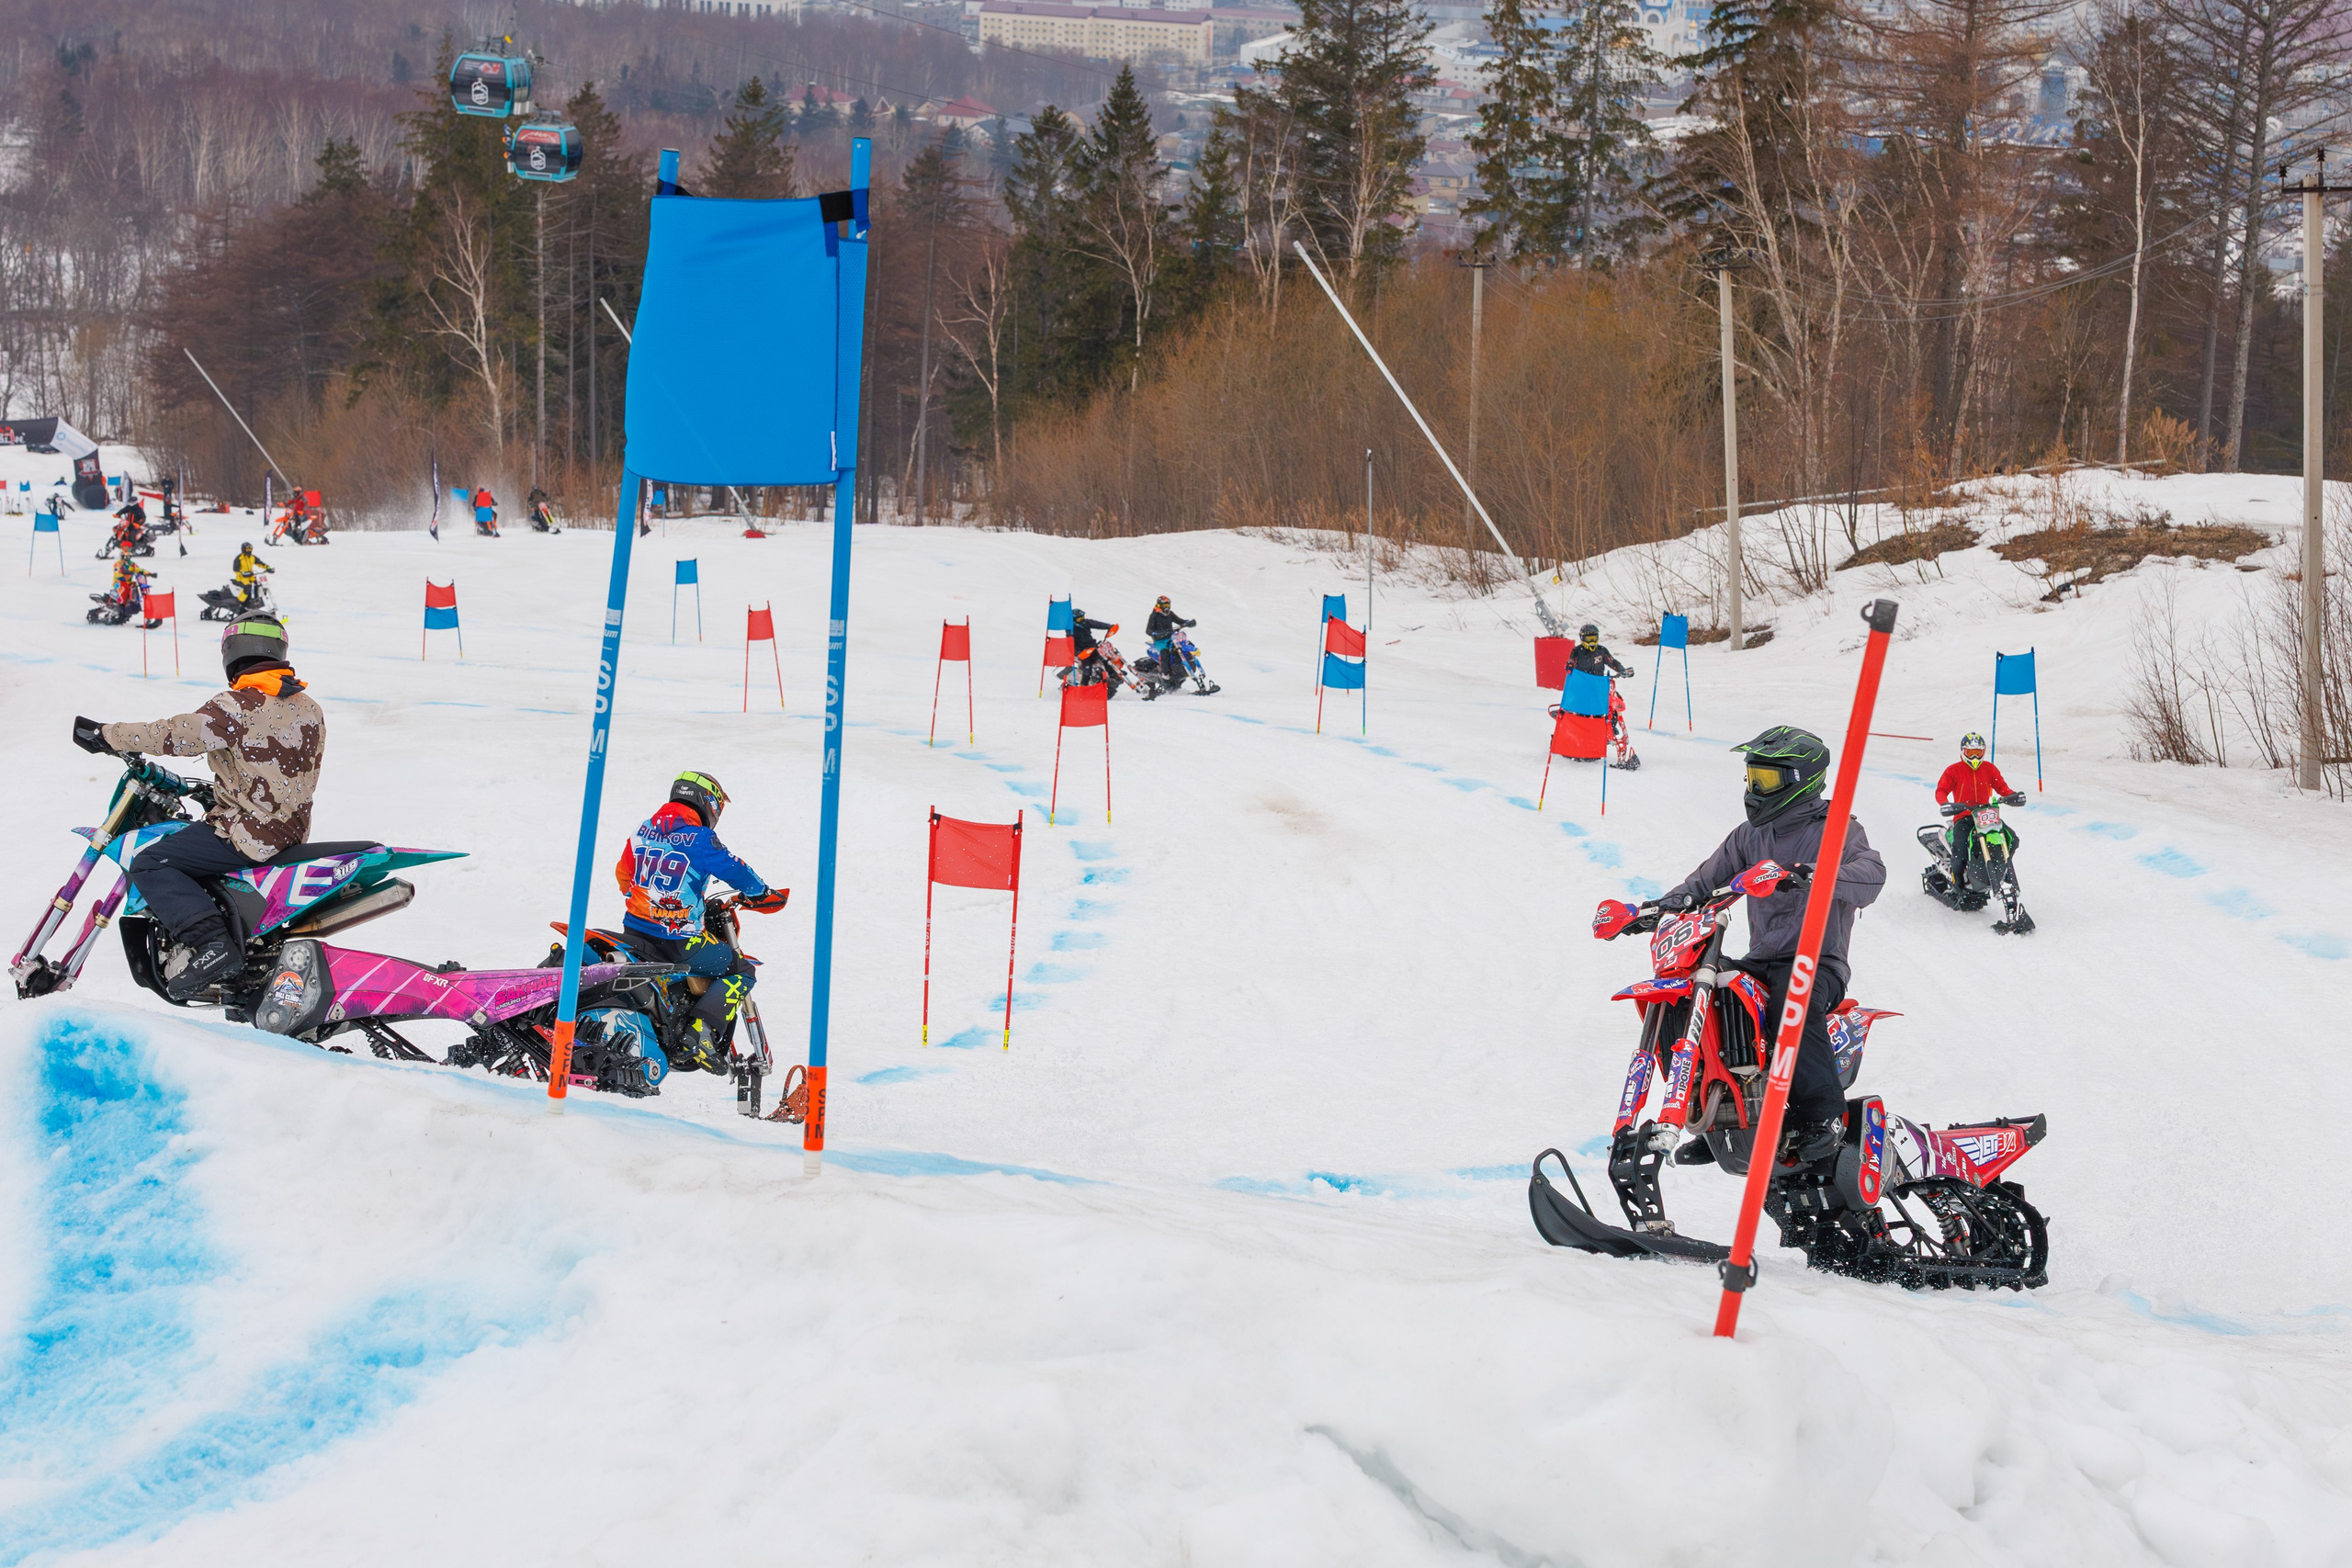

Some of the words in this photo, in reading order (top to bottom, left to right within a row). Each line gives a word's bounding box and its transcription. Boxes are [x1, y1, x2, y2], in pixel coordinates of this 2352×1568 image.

[1981, 812, 1996, 823] 03
[633, 845, 691, 893] 119
[192, 950, 216, 969] FXR
[1657, 920, 1694, 962] 06
[427, 973, 449, 988] FXR
[494, 970, 563, 1008] SAKHALI
[1770, 953, 1815, 1080] SPM
[1678, 1058, 1692, 1094] IPONE
